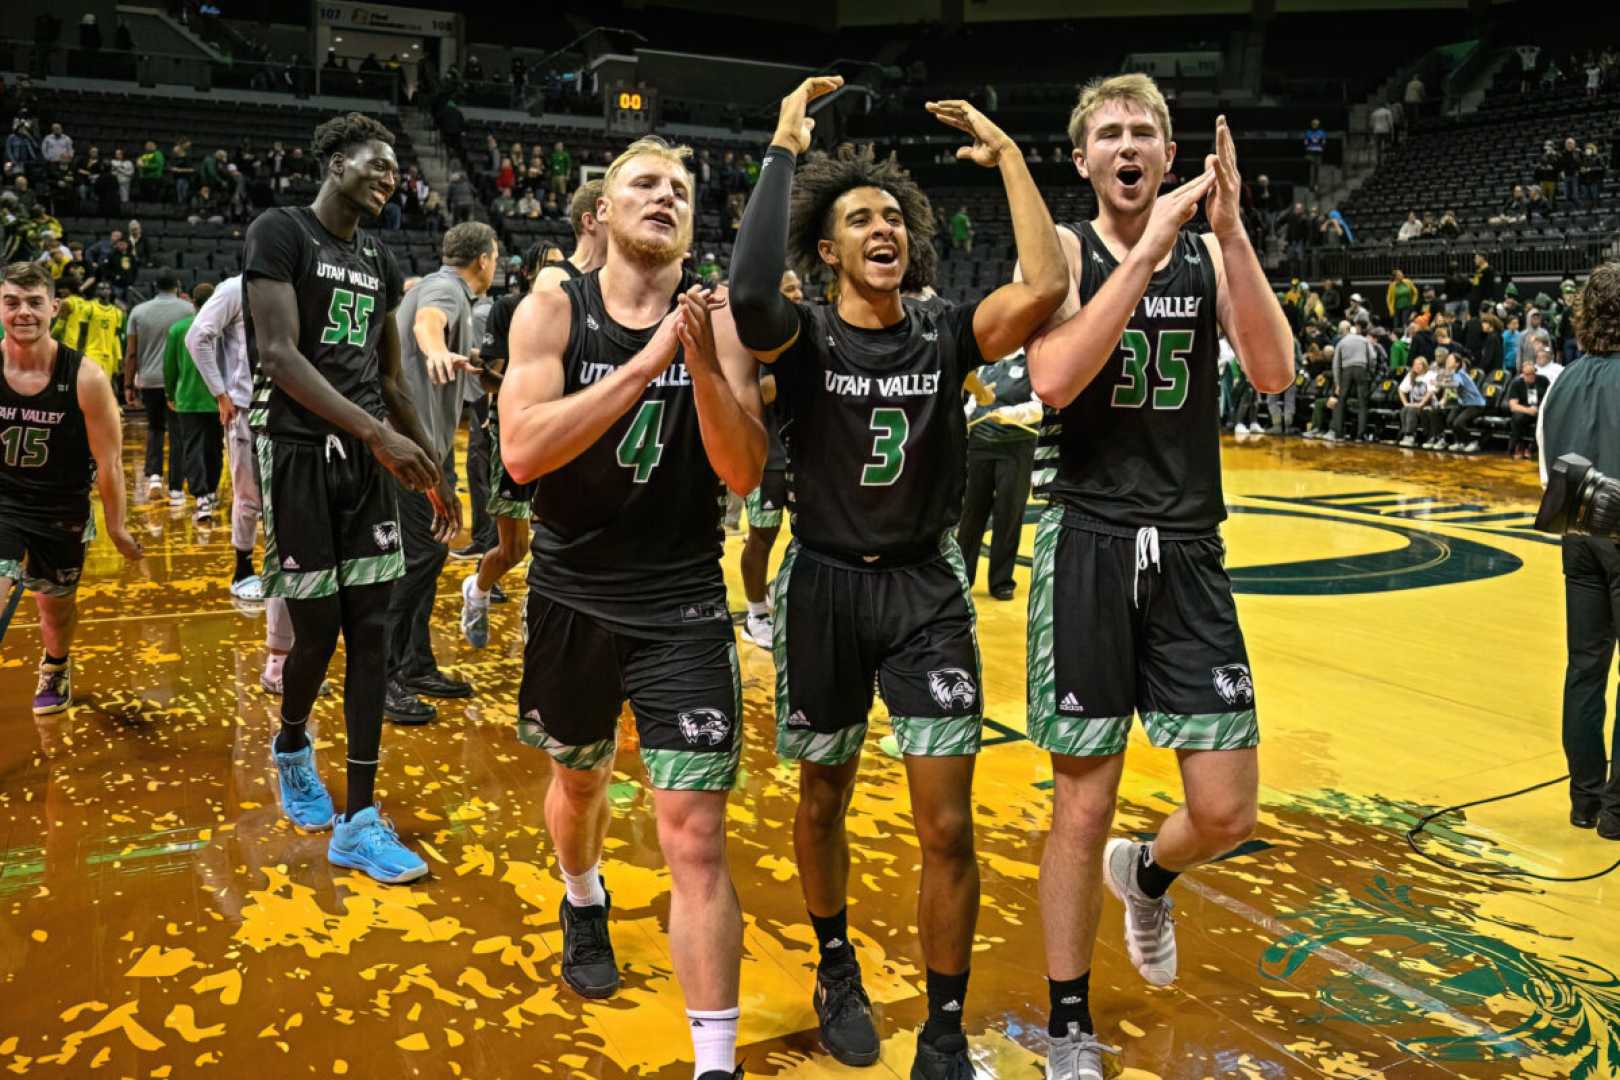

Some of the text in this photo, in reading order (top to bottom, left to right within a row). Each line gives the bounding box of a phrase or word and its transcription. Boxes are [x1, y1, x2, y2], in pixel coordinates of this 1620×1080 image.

[316, 261, 379, 291] UTAH VALLEY
[320, 288, 375, 348] 55
[825, 369, 942, 398] UTAH VALLEY
[1111, 328, 1195, 410] 35
[0, 406, 65, 424] AH VALLEY
[0, 426, 51, 467] 15
[616, 399, 665, 483] 4
[860, 407, 910, 487] 3
